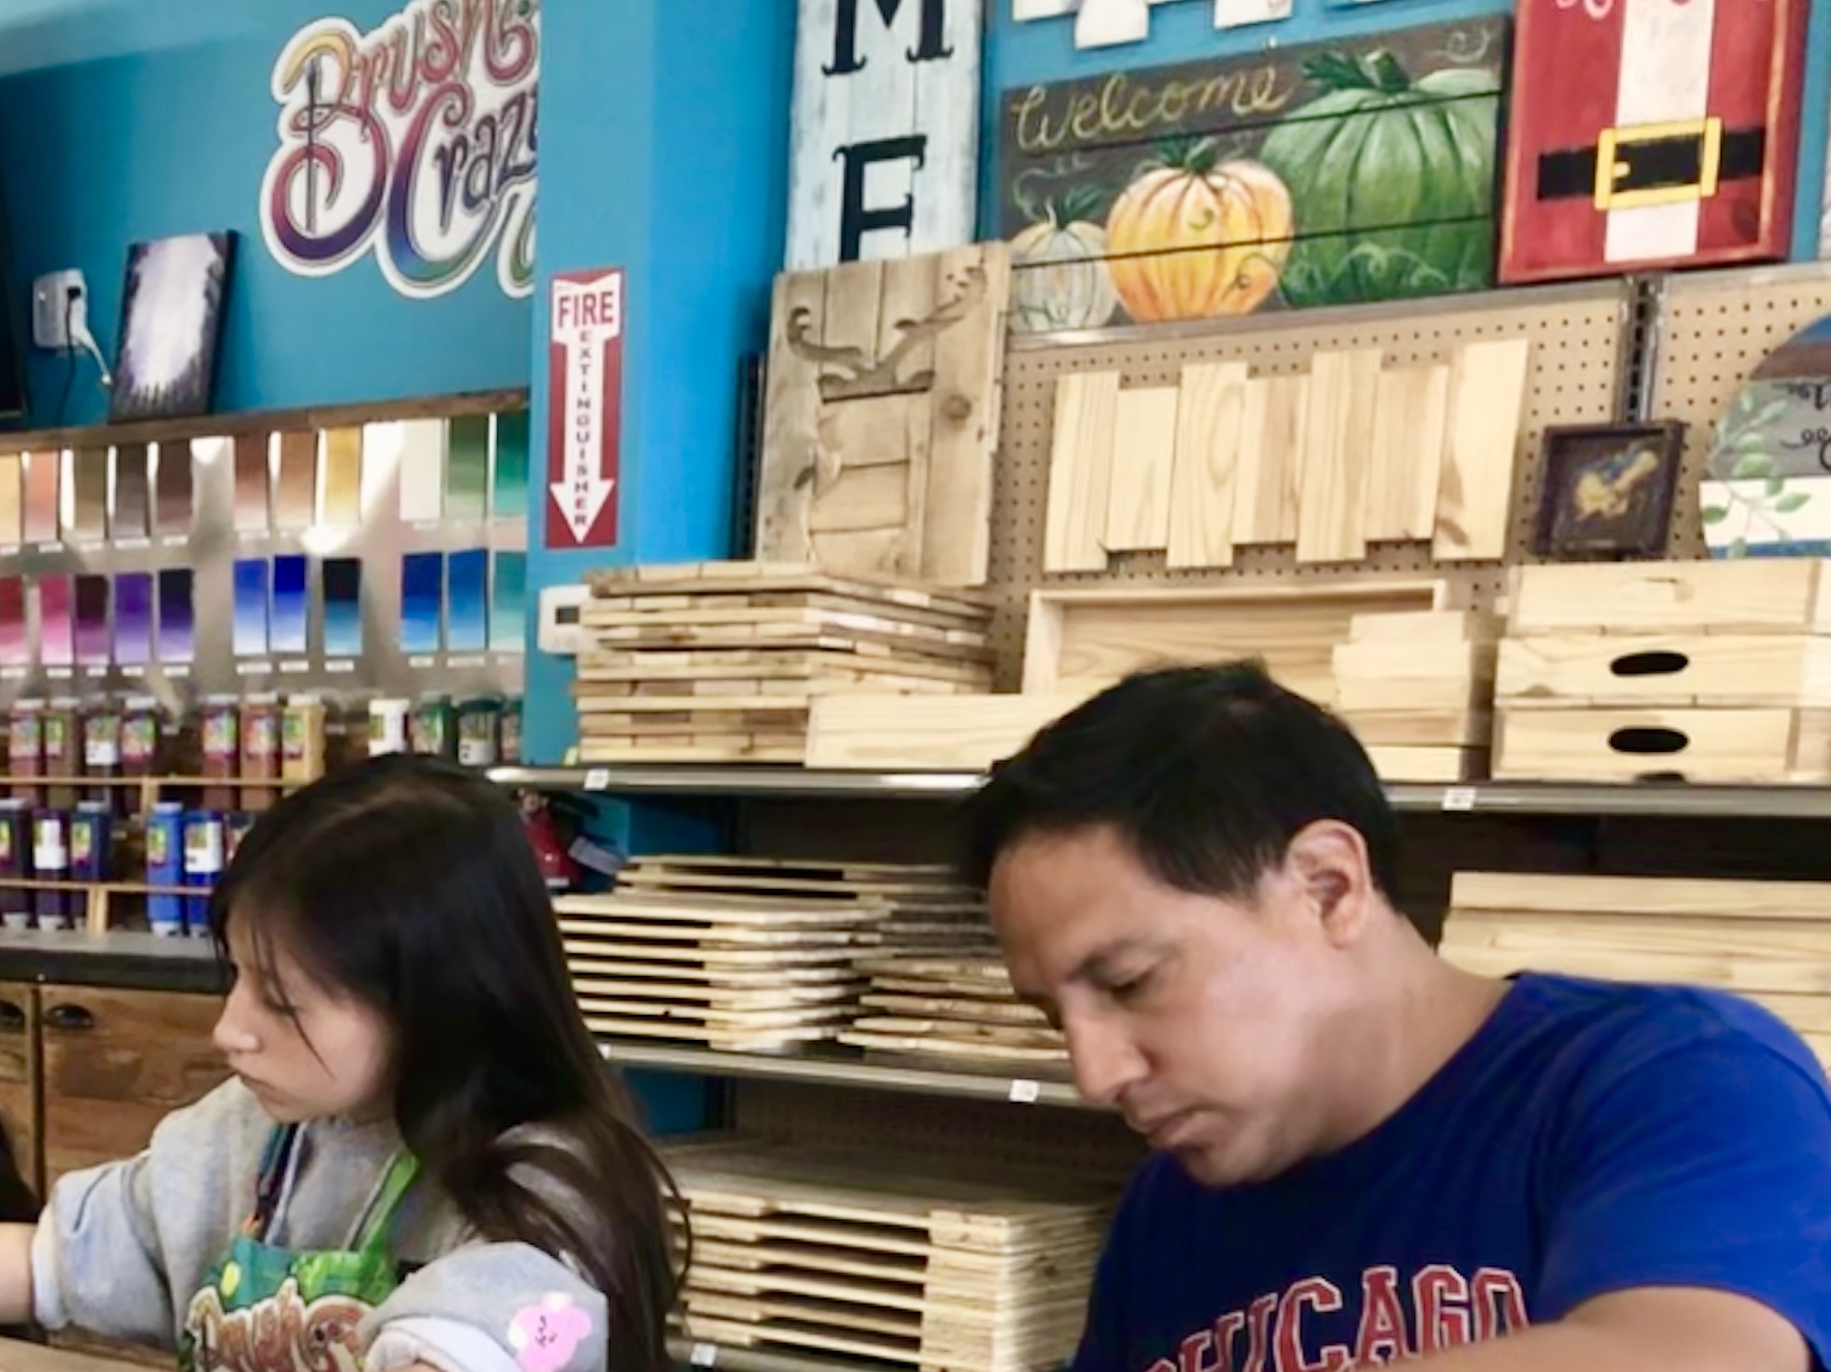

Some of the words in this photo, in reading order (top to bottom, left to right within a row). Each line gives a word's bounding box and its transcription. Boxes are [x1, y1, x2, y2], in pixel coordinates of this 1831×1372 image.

[1010, 65, 1295, 149] Welcome
[557, 290, 614, 329] FIRE
[573, 330, 593, 527] EXTINGUISHER
